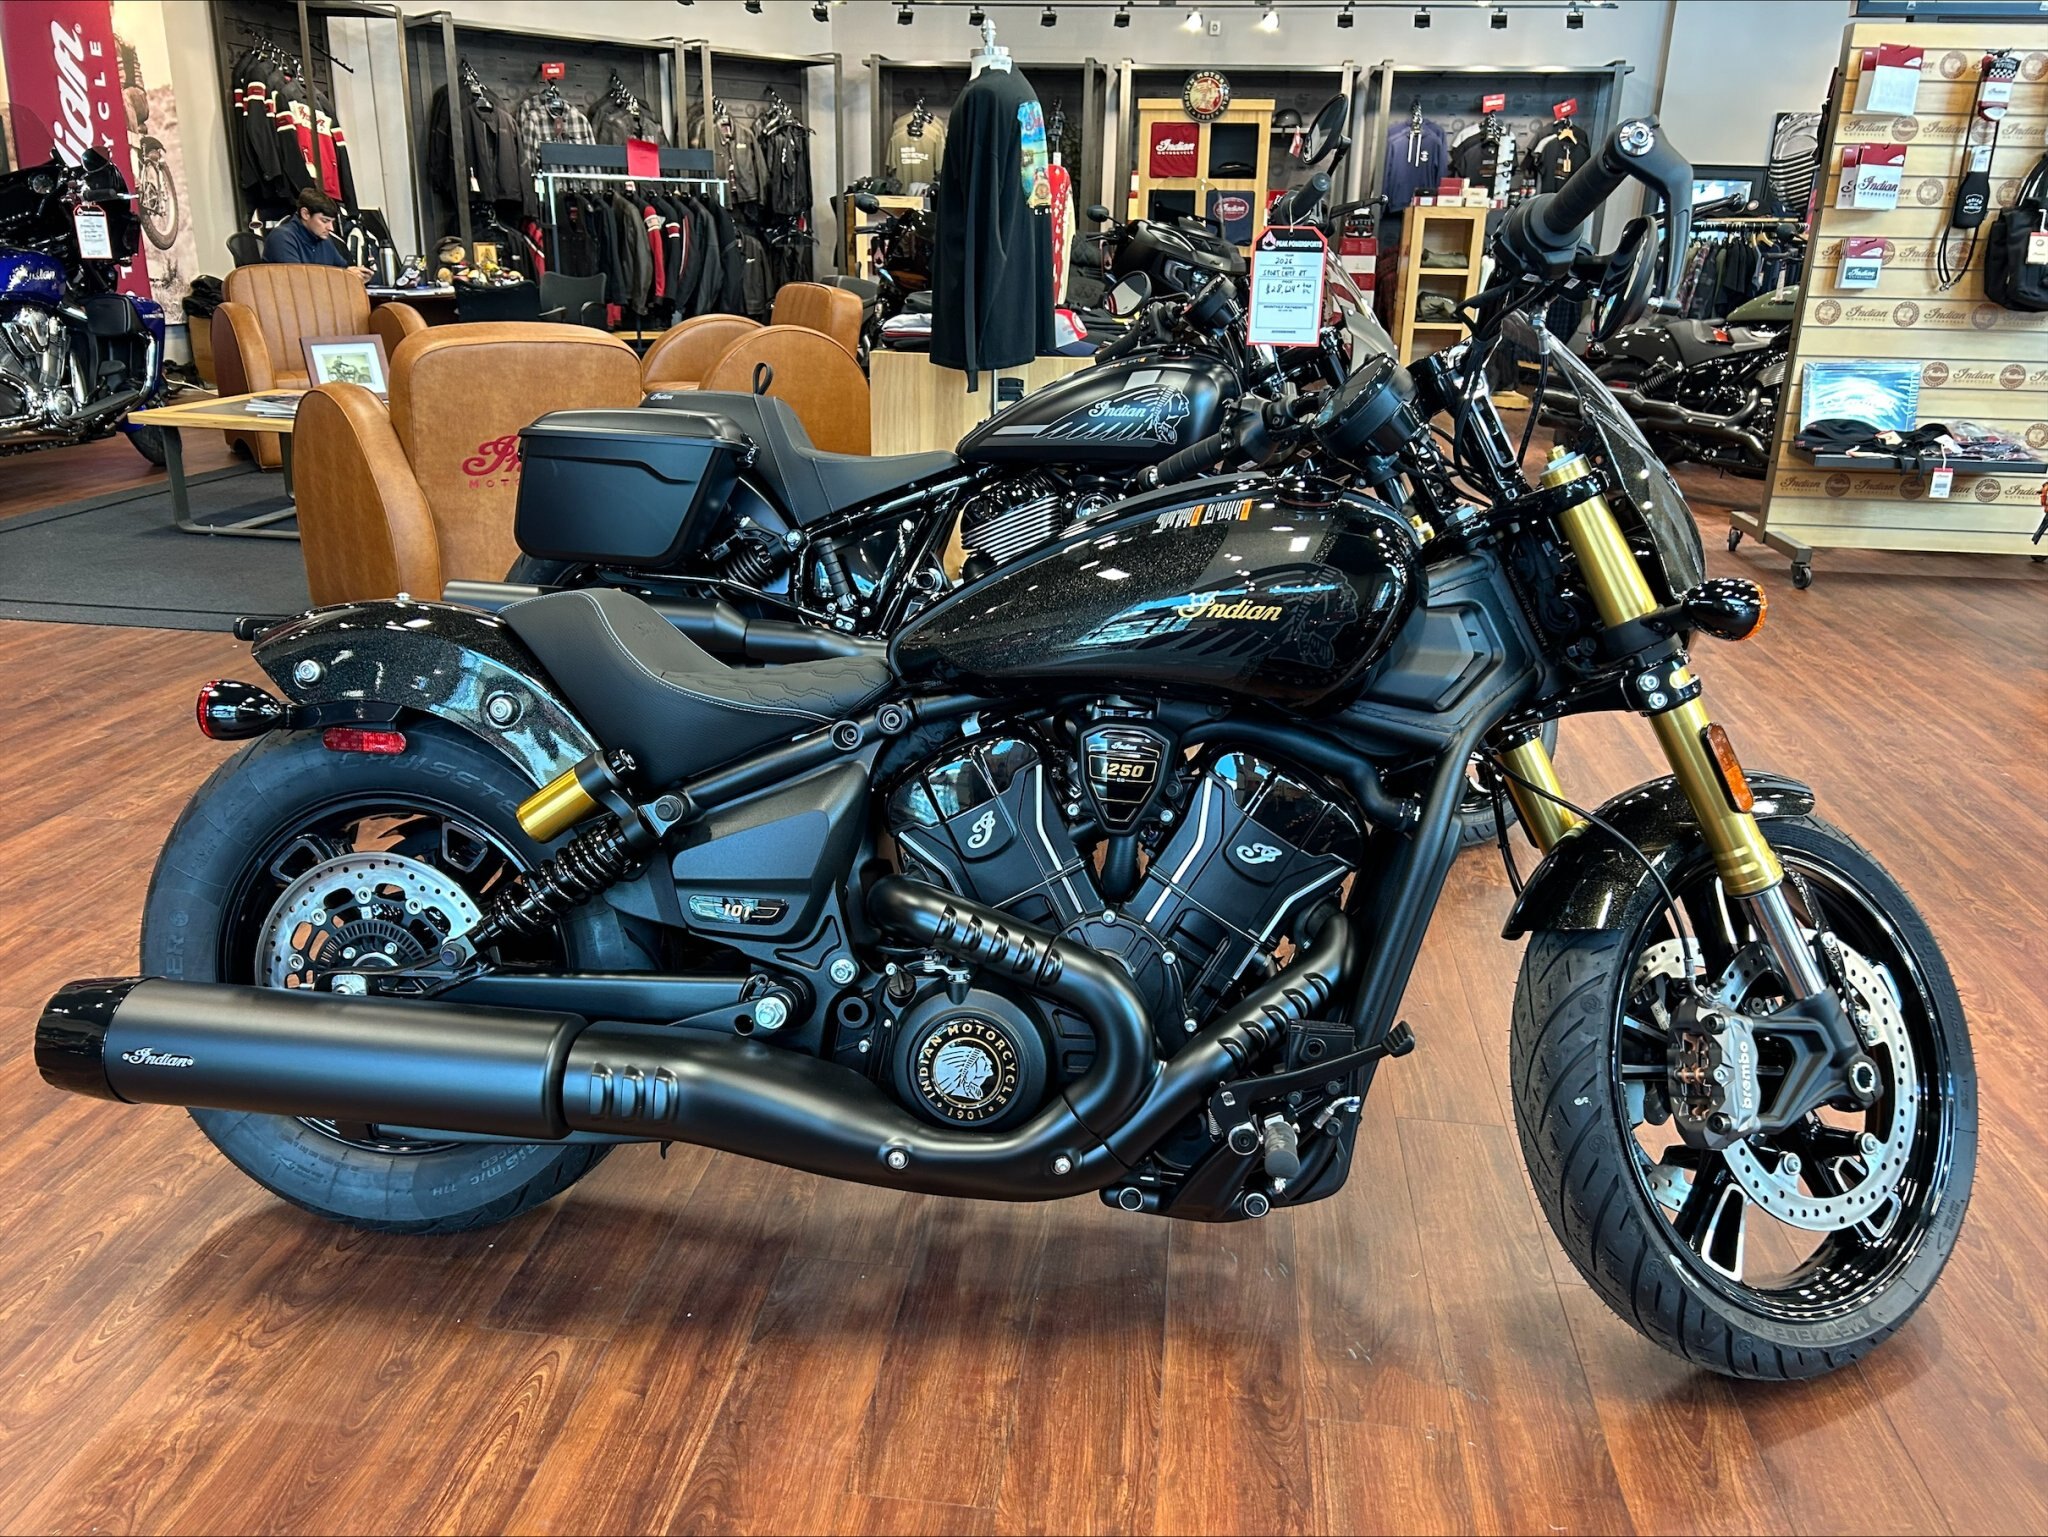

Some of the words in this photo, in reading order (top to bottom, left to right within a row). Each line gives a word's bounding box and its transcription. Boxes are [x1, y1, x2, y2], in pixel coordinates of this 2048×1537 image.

[1844, 119, 1888, 133] Indian
[1922, 120, 1967, 134] Indian
[1156, 139, 1196, 152] Indian
[1858, 175, 1898, 192] Indian
[1845, 305, 1889, 318] Indian
[1924, 307, 1968, 320] Indian
[1953, 367, 1996, 380] Indian
[1088, 401, 1146, 418] Indian
[1780, 476, 1821, 488] Indian
[1854, 479, 1896, 491] Indian
[1172, 591, 1283, 622] Indian
[1111, 741, 1138, 751] Indian
[1101, 762, 1145, 778] 1250
[723, 903, 751, 919] 101
[128, 1047, 187, 1068] Indian
[919, 1036, 943, 1100] INDIAN
[947, 1023, 1017, 1106] MOTORCYCLE
[1738, 1041, 1753, 1109] brembo
[947, 1107, 984, 1121] 1901
[1763, 1316, 1870, 1342] METZELER
